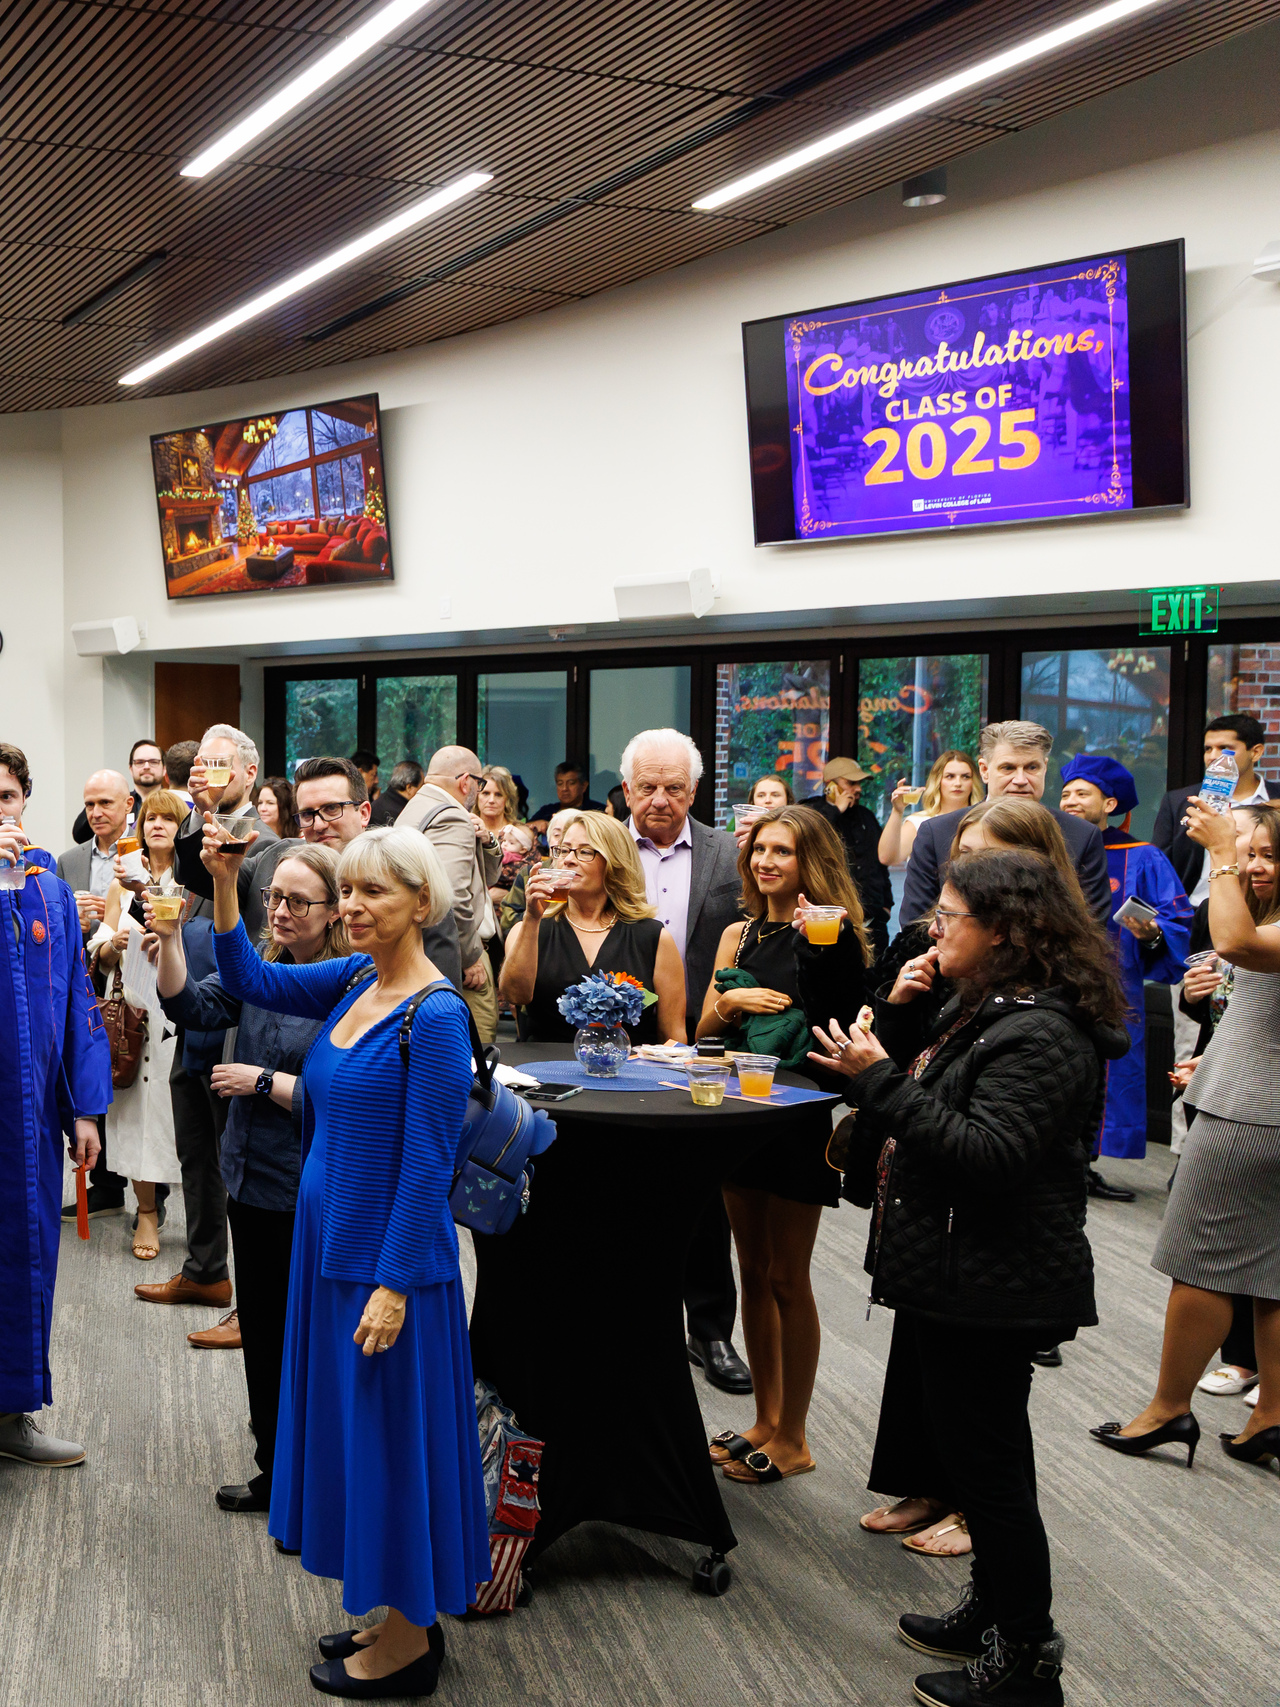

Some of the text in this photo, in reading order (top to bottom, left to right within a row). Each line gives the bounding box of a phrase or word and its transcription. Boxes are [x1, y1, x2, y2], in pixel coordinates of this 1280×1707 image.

[803, 329, 1105, 398] Congratulations,
[884, 384, 1012, 422] CLASS OF
[861, 407, 1041, 486] 2025
[924, 502, 942, 510] LEVIN
[942, 499, 969, 508] COLLEGE
[977, 497, 992, 505] LAW
[1151, 592, 1206, 631] EXIT
